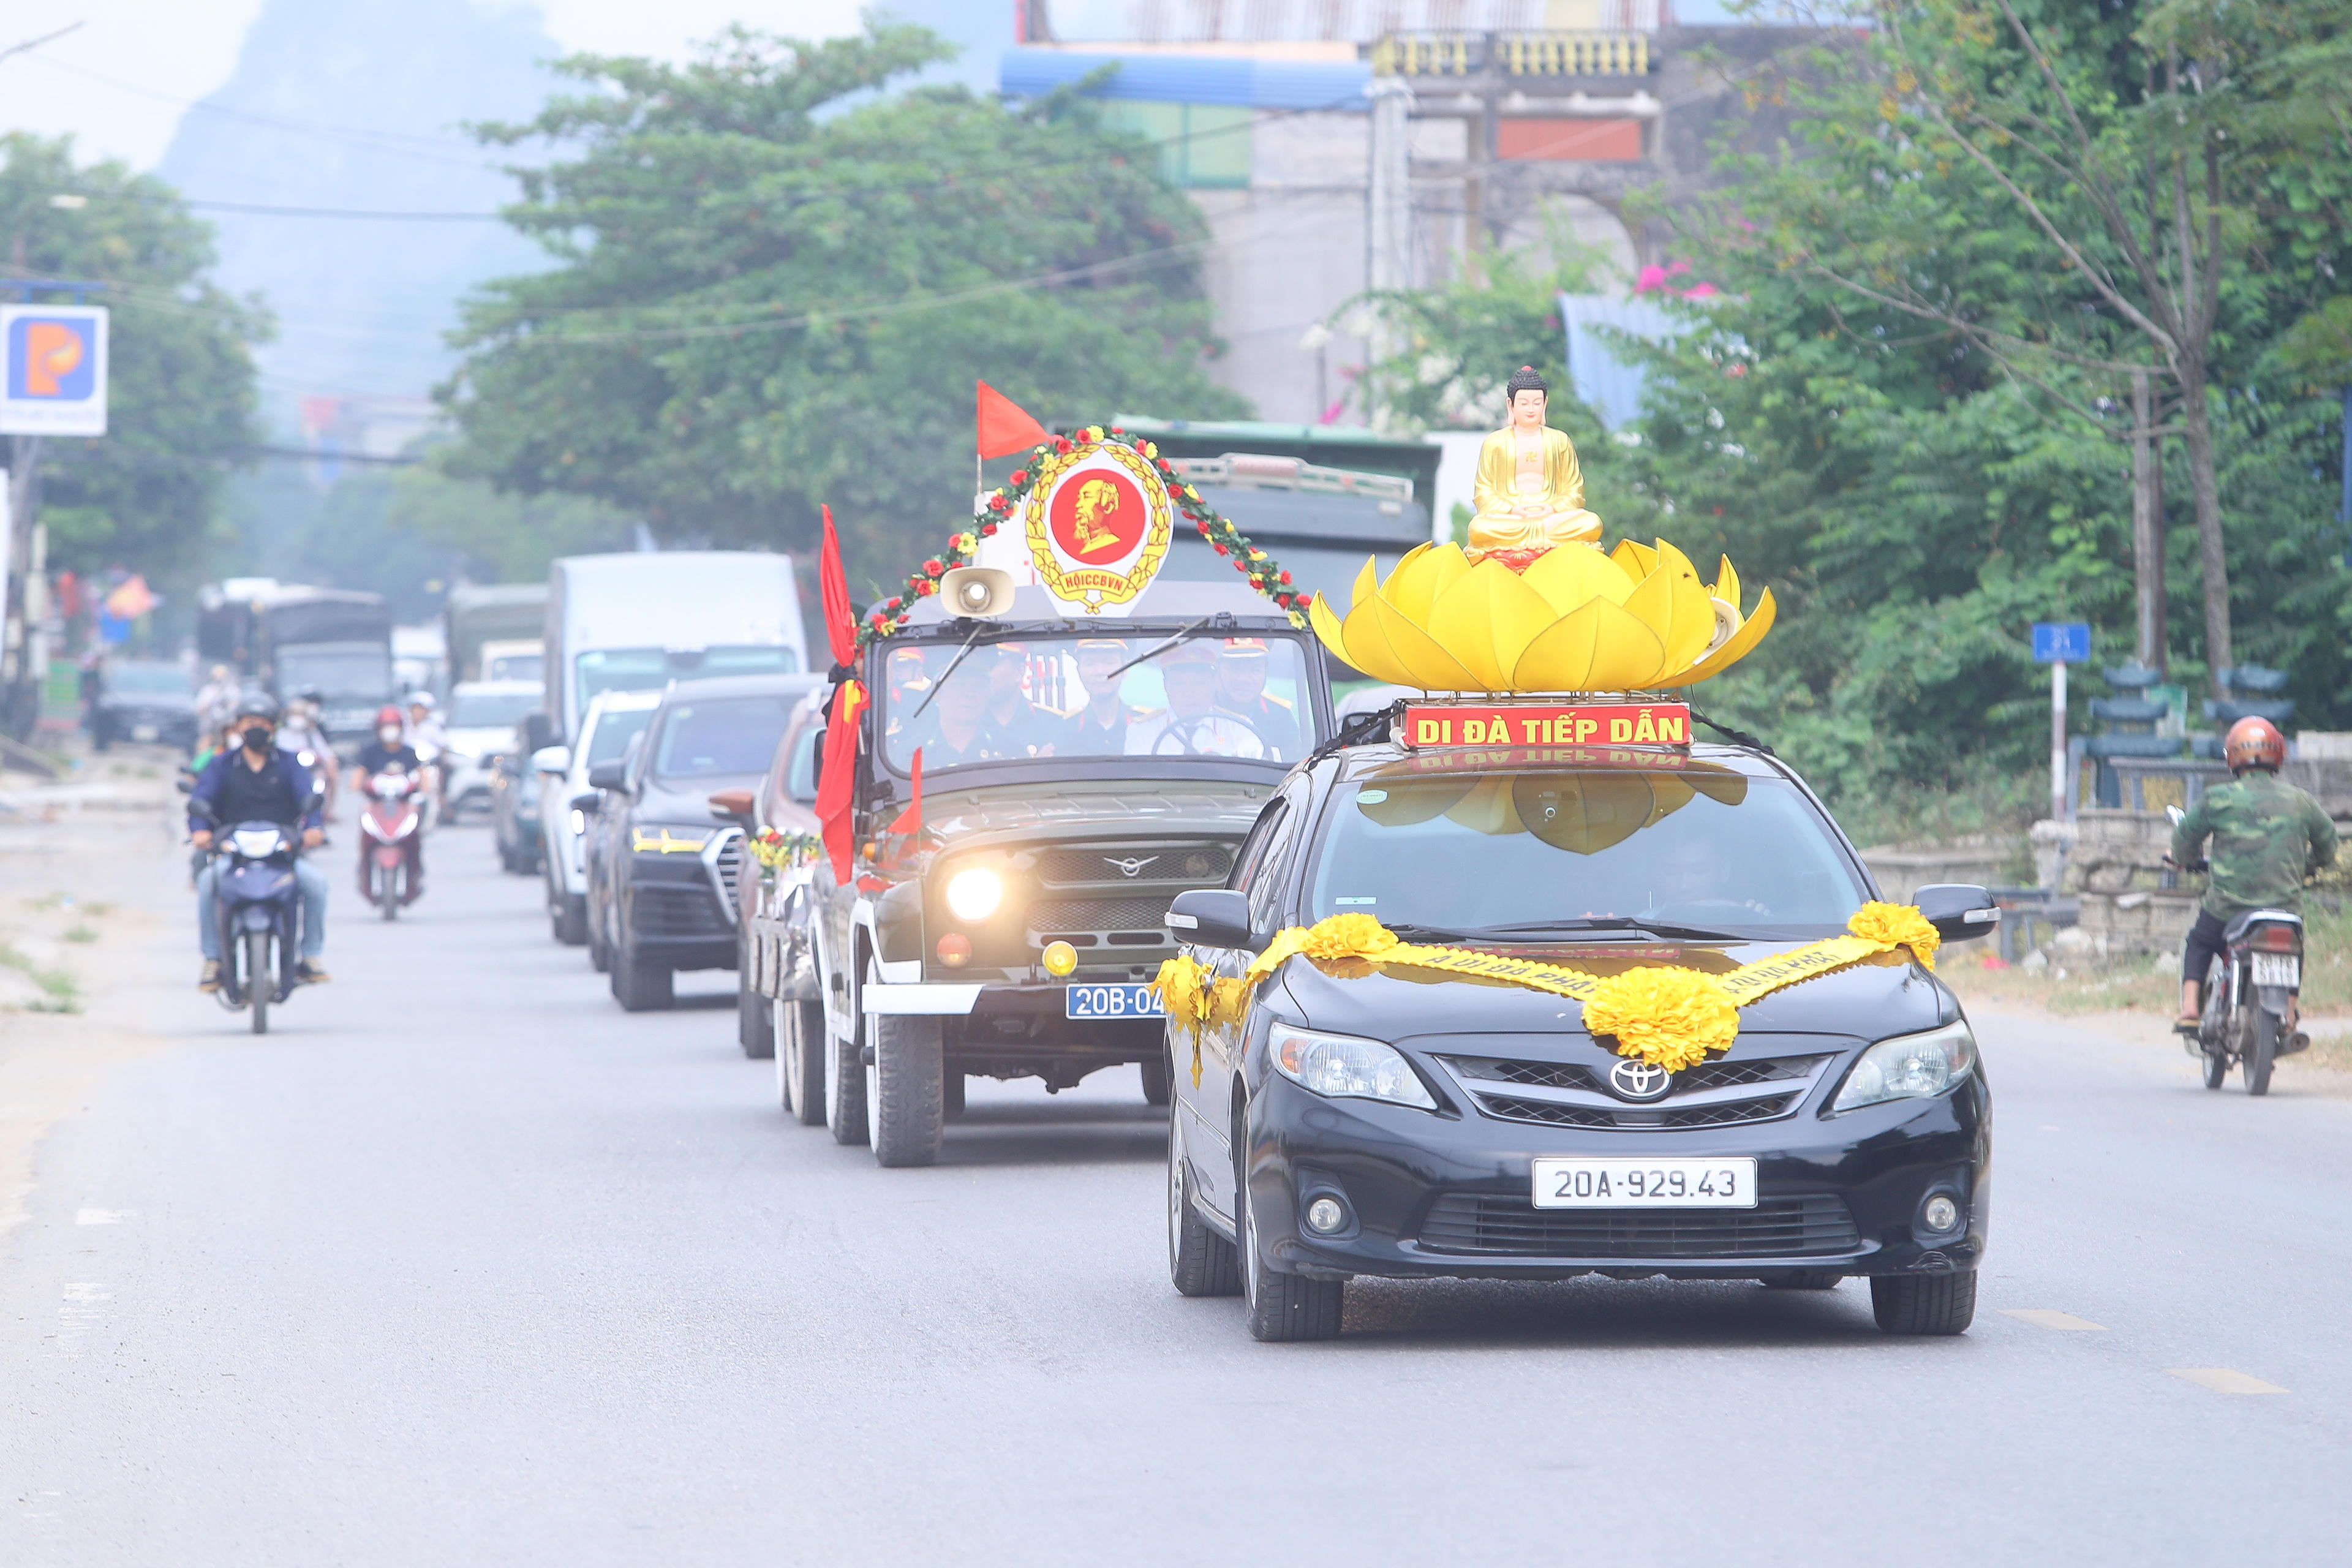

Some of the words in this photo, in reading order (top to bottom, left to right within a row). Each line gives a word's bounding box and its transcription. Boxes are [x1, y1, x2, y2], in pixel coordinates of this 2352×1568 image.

[1417, 719, 1452, 744] DI
[1462, 714, 1512, 744] ĐÀ
[1521, 711, 1598, 744] TIẾP
[1610, 708, 1684, 743] DẪN
[1555, 1170, 1736, 1197] 20A-929.43
